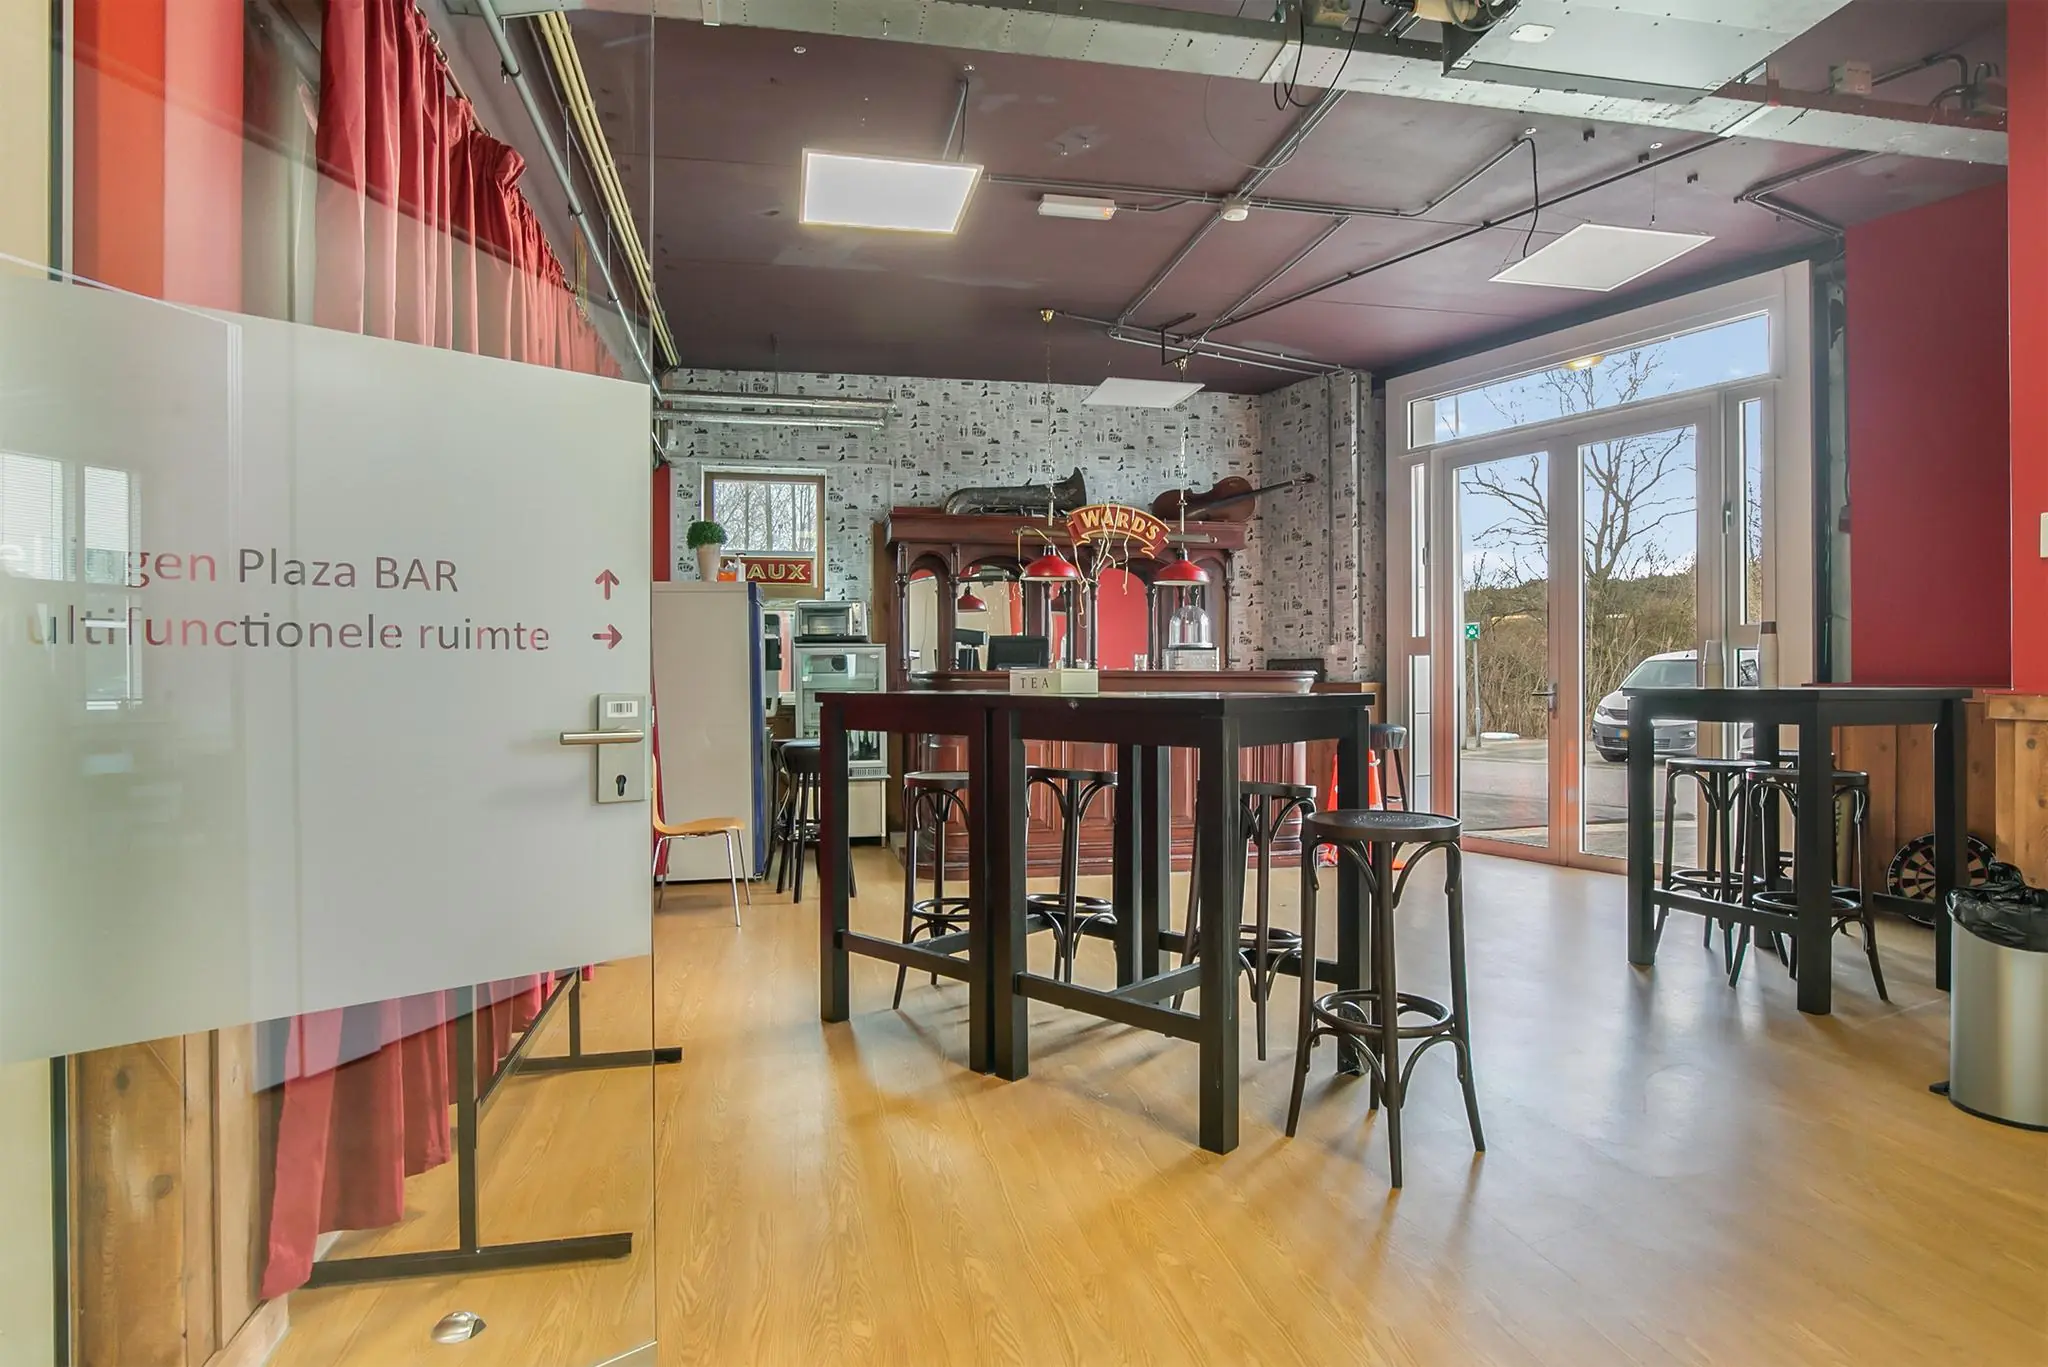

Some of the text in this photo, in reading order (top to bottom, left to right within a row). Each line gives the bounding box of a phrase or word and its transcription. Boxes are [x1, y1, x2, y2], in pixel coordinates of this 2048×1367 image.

[1080, 508, 1160, 541] WARD'S
[238, 547, 357, 588] Plaza
[375, 556, 459, 593] BAR
[25, 604, 550, 651] ultifunctionele ruimte
[1020, 677, 1050, 689] TEA
